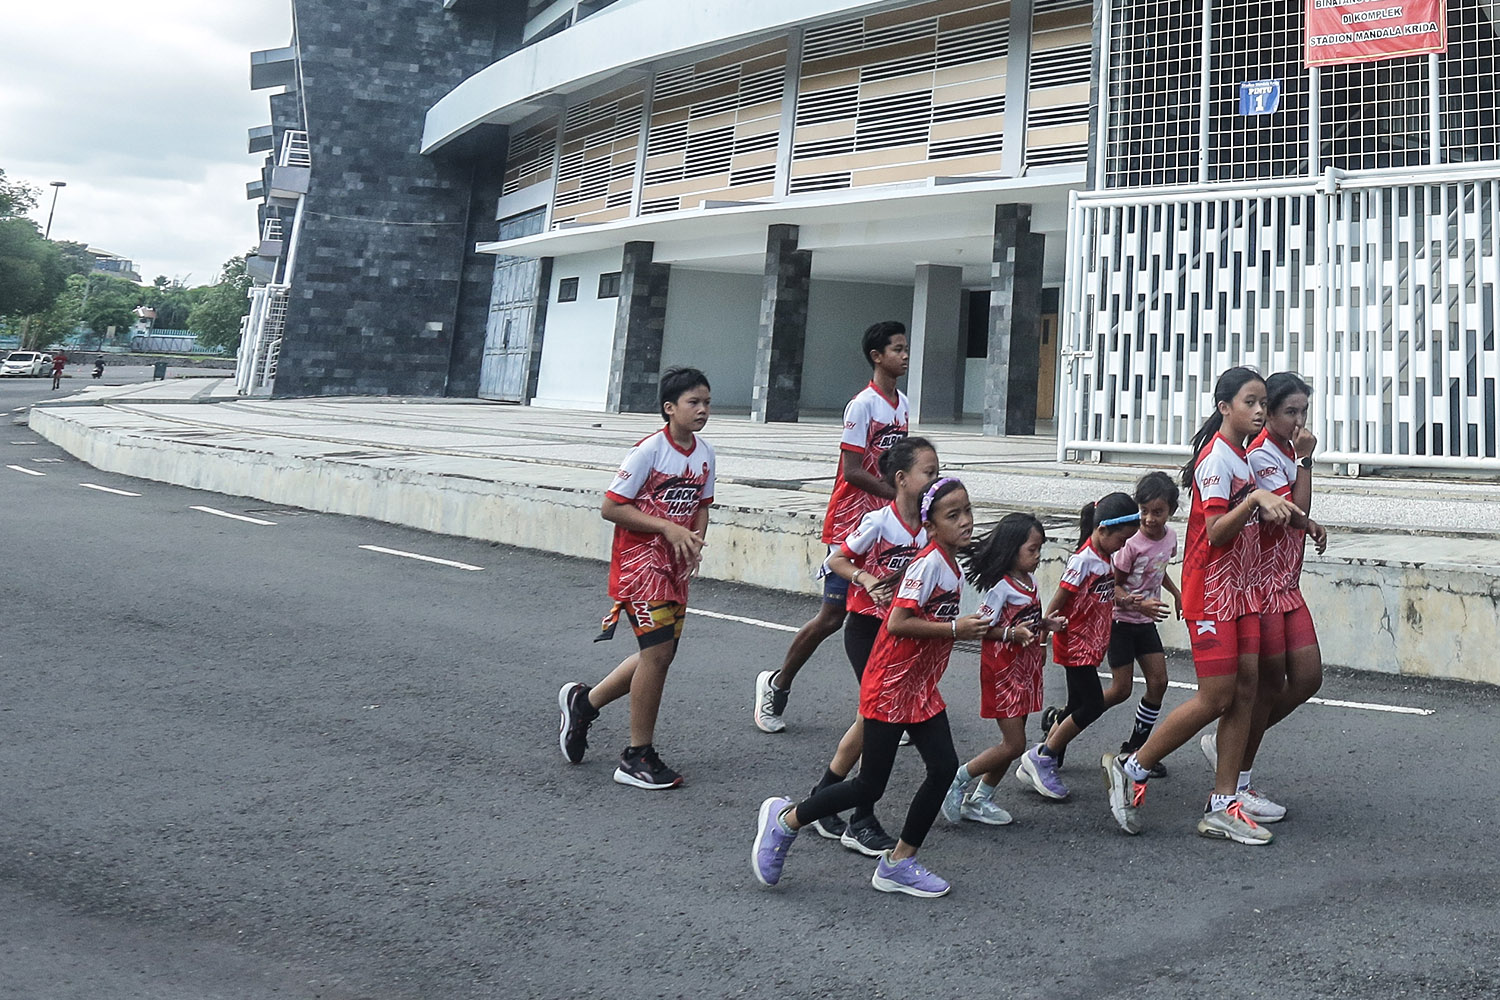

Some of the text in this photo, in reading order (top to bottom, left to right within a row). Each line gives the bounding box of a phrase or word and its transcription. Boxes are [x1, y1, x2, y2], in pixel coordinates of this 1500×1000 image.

[1342, 7, 1402, 24] DI KOMPLEK
[1310, 22, 1438, 46] STADION MANDALA KRIDA
[1248, 87, 1273, 95] PINTU
[1256, 95, 1264, 112] 1
